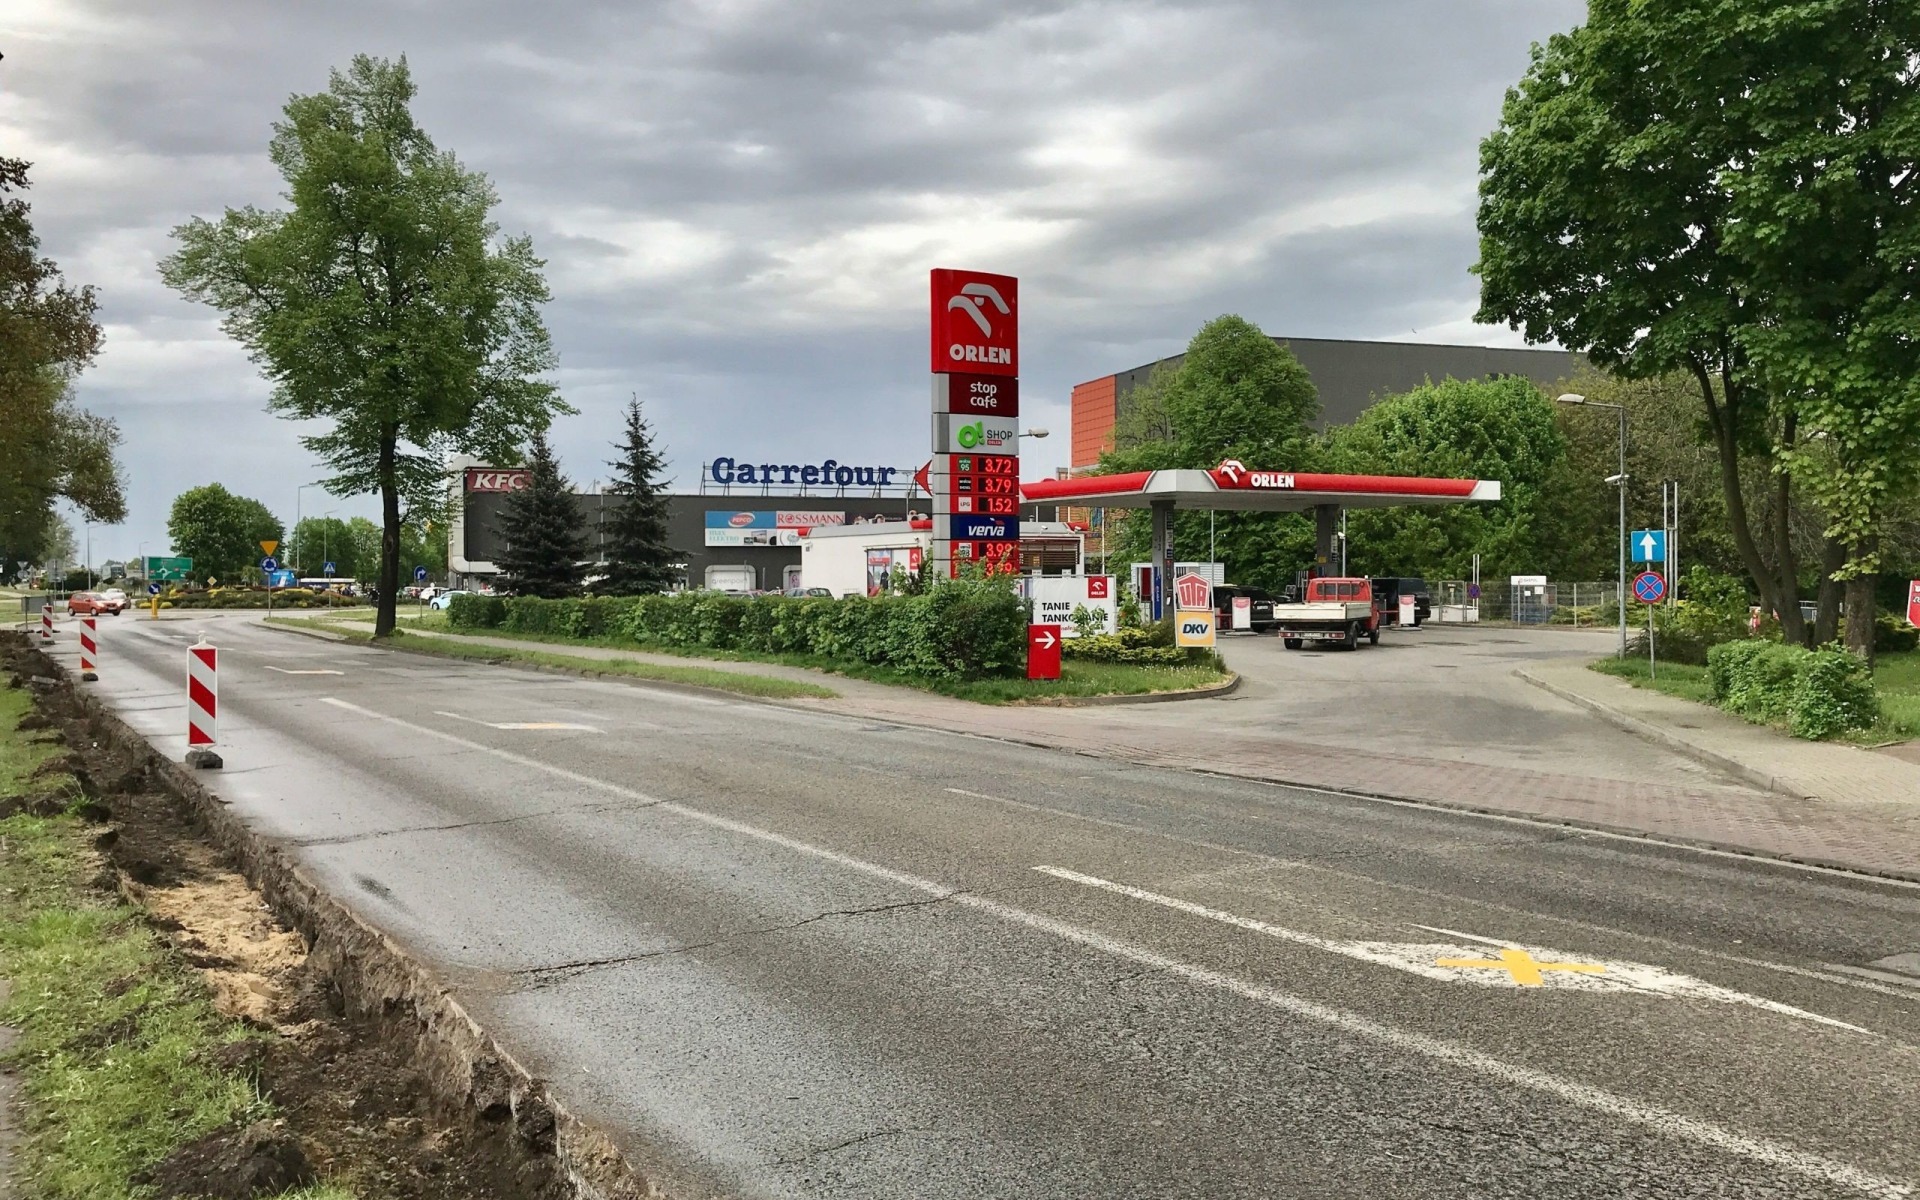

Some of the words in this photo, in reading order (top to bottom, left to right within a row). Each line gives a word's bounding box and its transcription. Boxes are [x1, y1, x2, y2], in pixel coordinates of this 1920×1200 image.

[949, 343, 1011, 365] ORLEN
[970, 381, 997, 397] stop
[970, 396, 997, 408] cafe
[986, 429, 1013, 440] SHOP
[712, 457, 896, 486] Carrefour
[985, 458, 1012, 473] 3.72
[473, 473, 525, 489] KFC
[985, 478, 1012, 493] 3.79
[1250, 473, 1295, 488] ORLEN
[988, 498, 1012, 512] 1.52
[777, 513, 845, 525] ROSSMANN
[968, 525, 1005, 536] verva
[1178, 575, 1208, 607] UTA
[1042, 602, 1070, 611] TANIE
[1042, 612, 1109, 623] TANKOANIE
[1182, 623, 1209, 634] DKV
